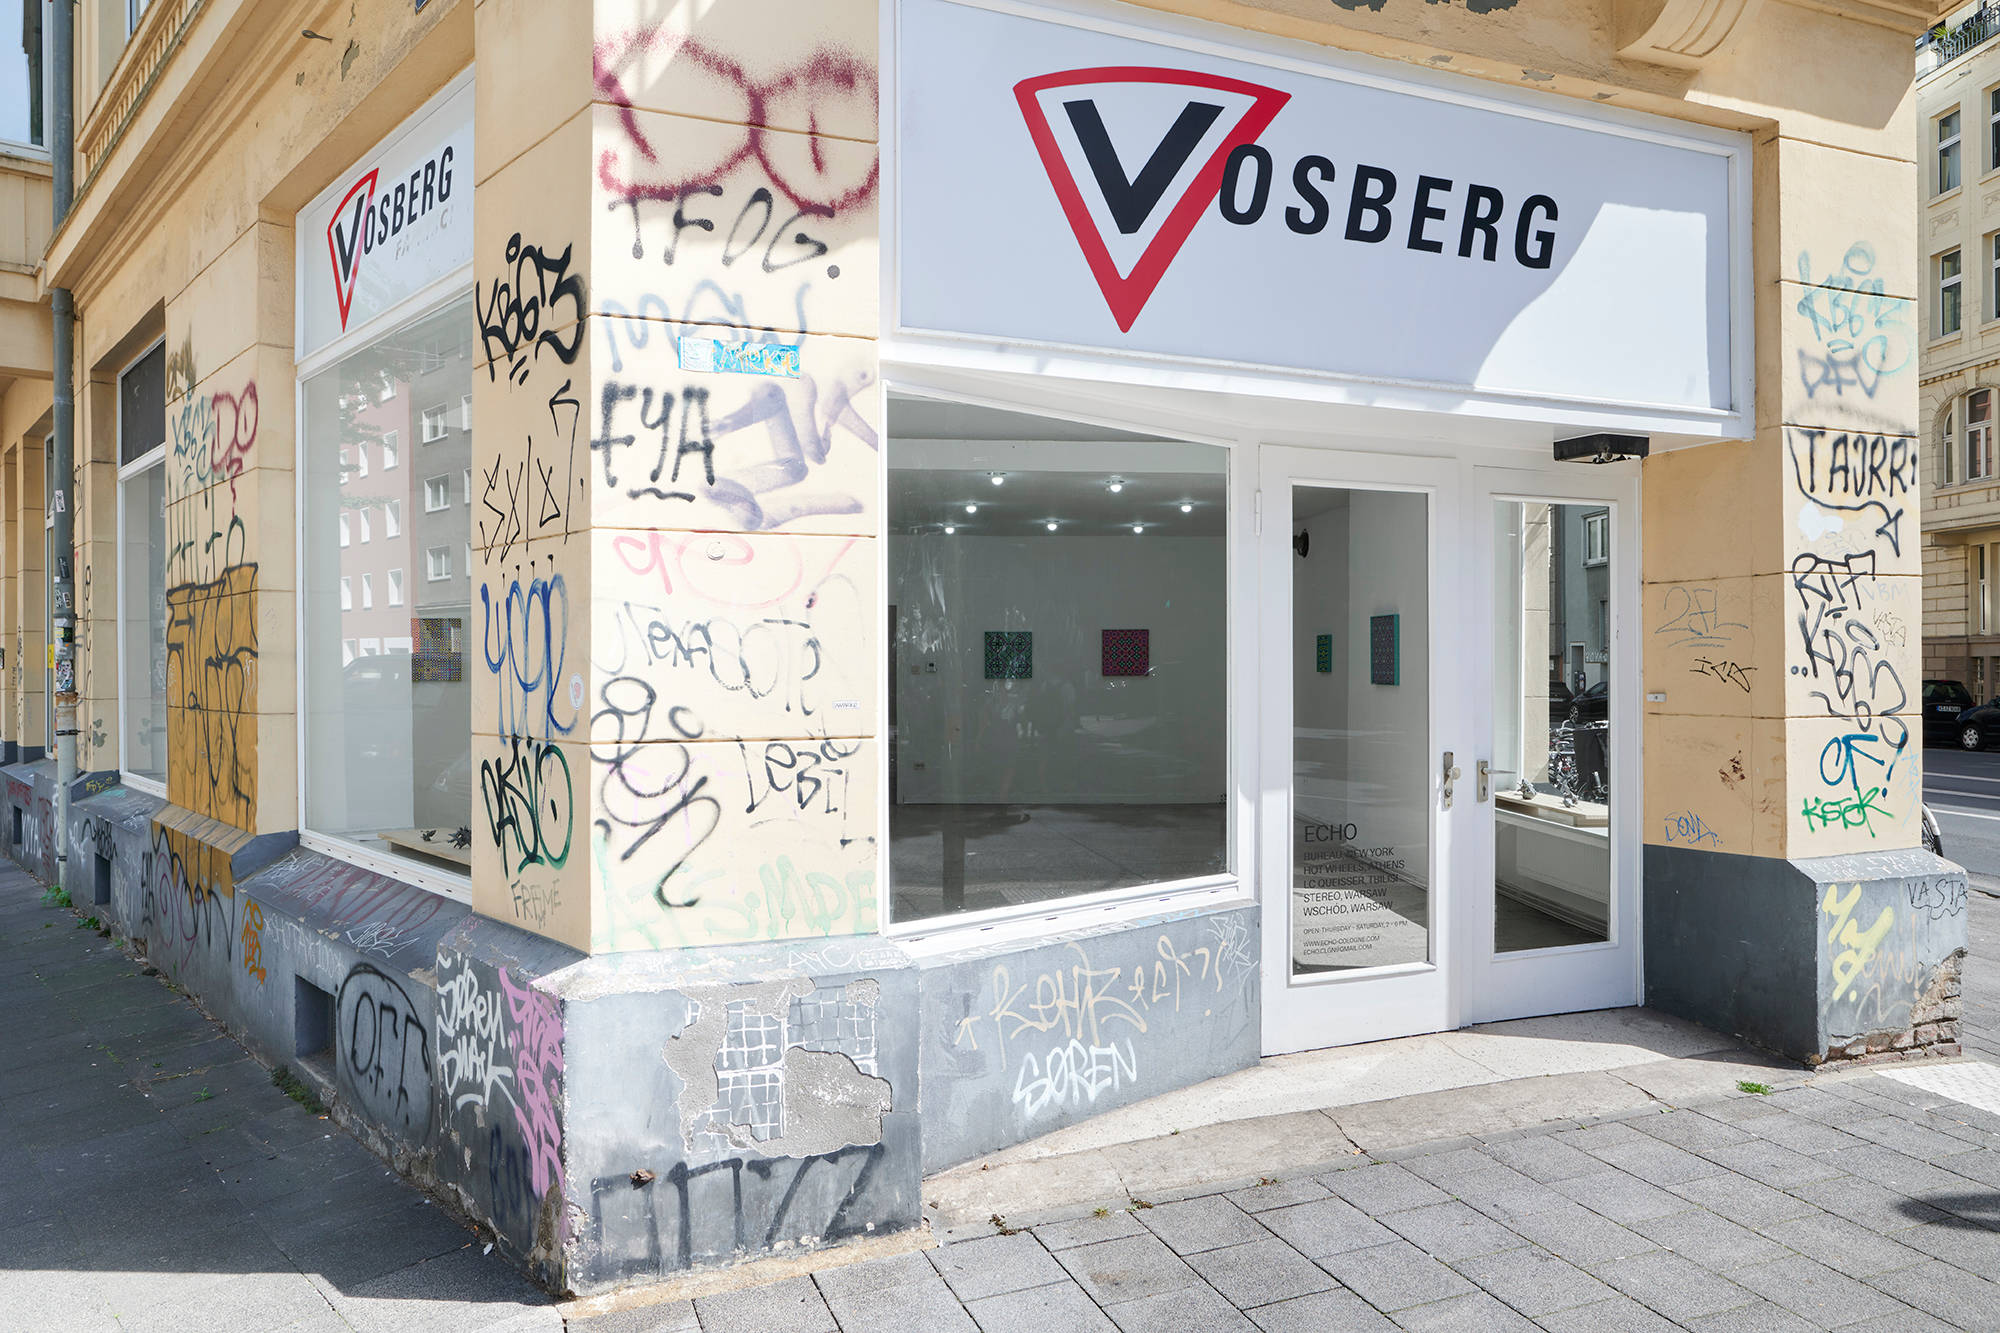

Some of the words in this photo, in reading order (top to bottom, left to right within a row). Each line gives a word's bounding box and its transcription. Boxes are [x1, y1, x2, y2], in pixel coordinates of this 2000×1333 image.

[1063, 99, 1560, 270] VOSBERG
[335, 146, 453, 283] VOSBERG
[1304, 823, 1358, 842] ECHO
[1303, 851, 1345, 861] BUREAU,
[1370, 847, 1394, 857] YORK
[1303, 865, 1323, 875] HOT
[1367, 859, 1405, 872] ATHENS
[1303, 879, 1316, 889] LC
[1369, 873, 1399, 885] TBILISI
[1303, 890, 1343, 903] STEREO,
[1344, 887, 1388, 900] WARSAW
[1303, 903, 1349, 916] WSCHÓD,
[1350, 900, 1394, 913] WARSAW
[1321, 925, 1351, 934] THURSDAY
